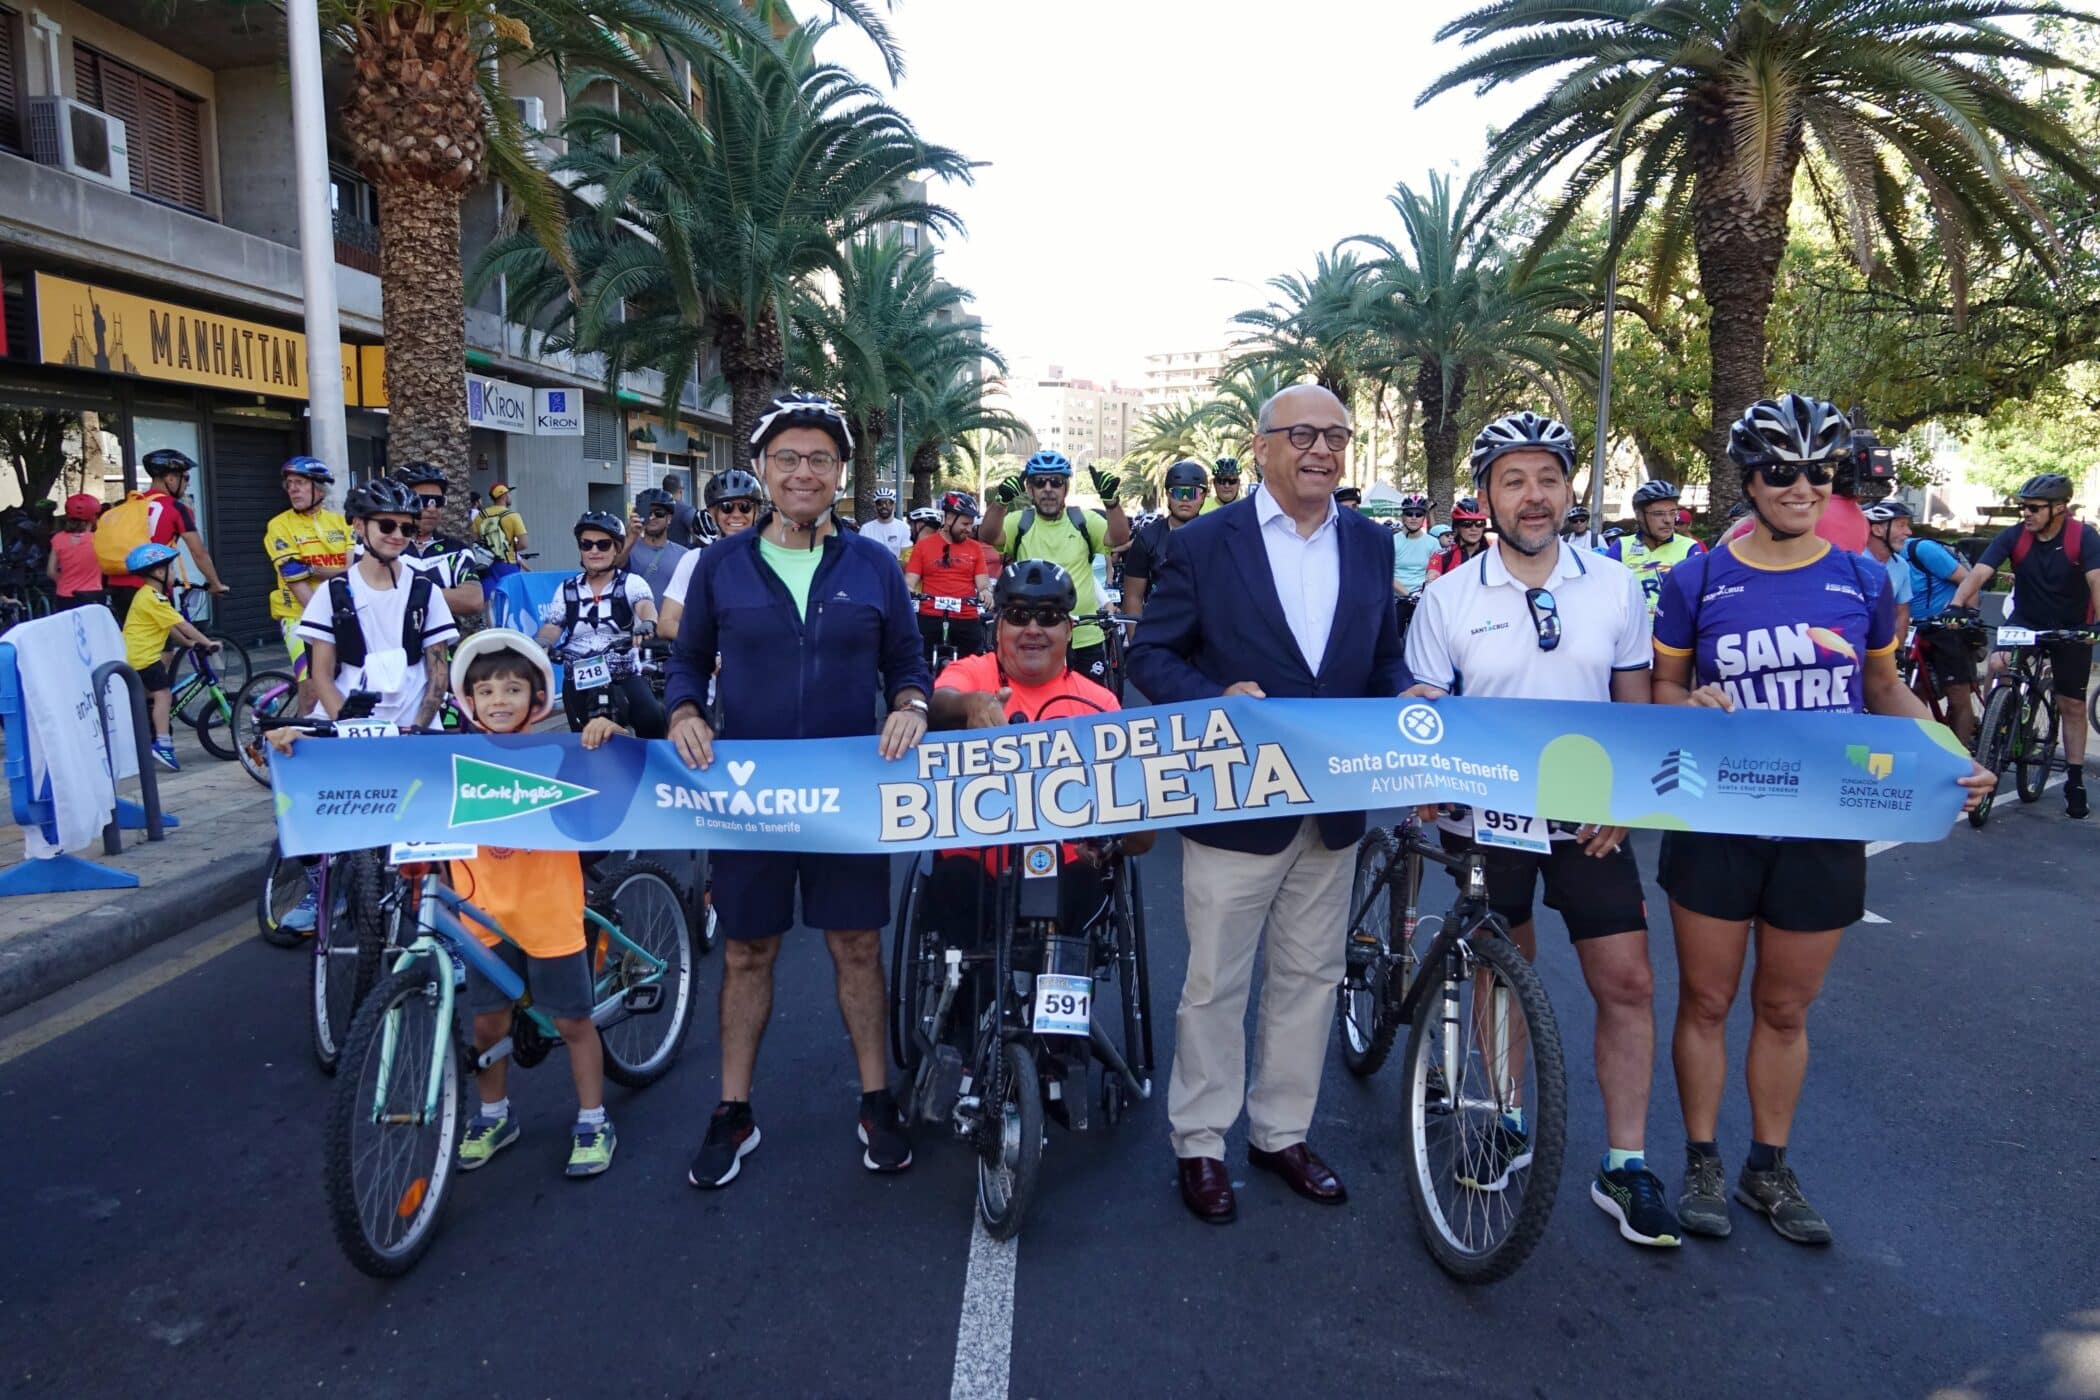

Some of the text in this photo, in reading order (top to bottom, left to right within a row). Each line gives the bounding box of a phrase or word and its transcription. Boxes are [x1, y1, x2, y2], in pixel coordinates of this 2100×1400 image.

[149, 308, 299, 388] MANHATTAN
[1715, 622, 1817, 679] SAN
[577, 665, 604, 681] 218
[917, 708, 1246, 779] FIESTA DE LA
[1328, 750, 1520, 783] Santa Cruz de Tenerife
[1719, 755, 1802, 773] Autoridad
[1371, 773, 1488, 796] AYUNTAMIENTO
[1718, 769, 1799, 786] Portuaria
[318, 788, 398, 801] SANTA CRUZ
[877, 742, 1315, 842] BICICLETA
[1840, 785, 1914, 799] SANTA CRUZ
[1839, 797, 1913, 811] SOSTENIBLE
[695, 815, 801, 833] El corazón de Tenerife
[1484, 809, 1534, 834] 957
[1044, 993, 1089, 1017] 591
